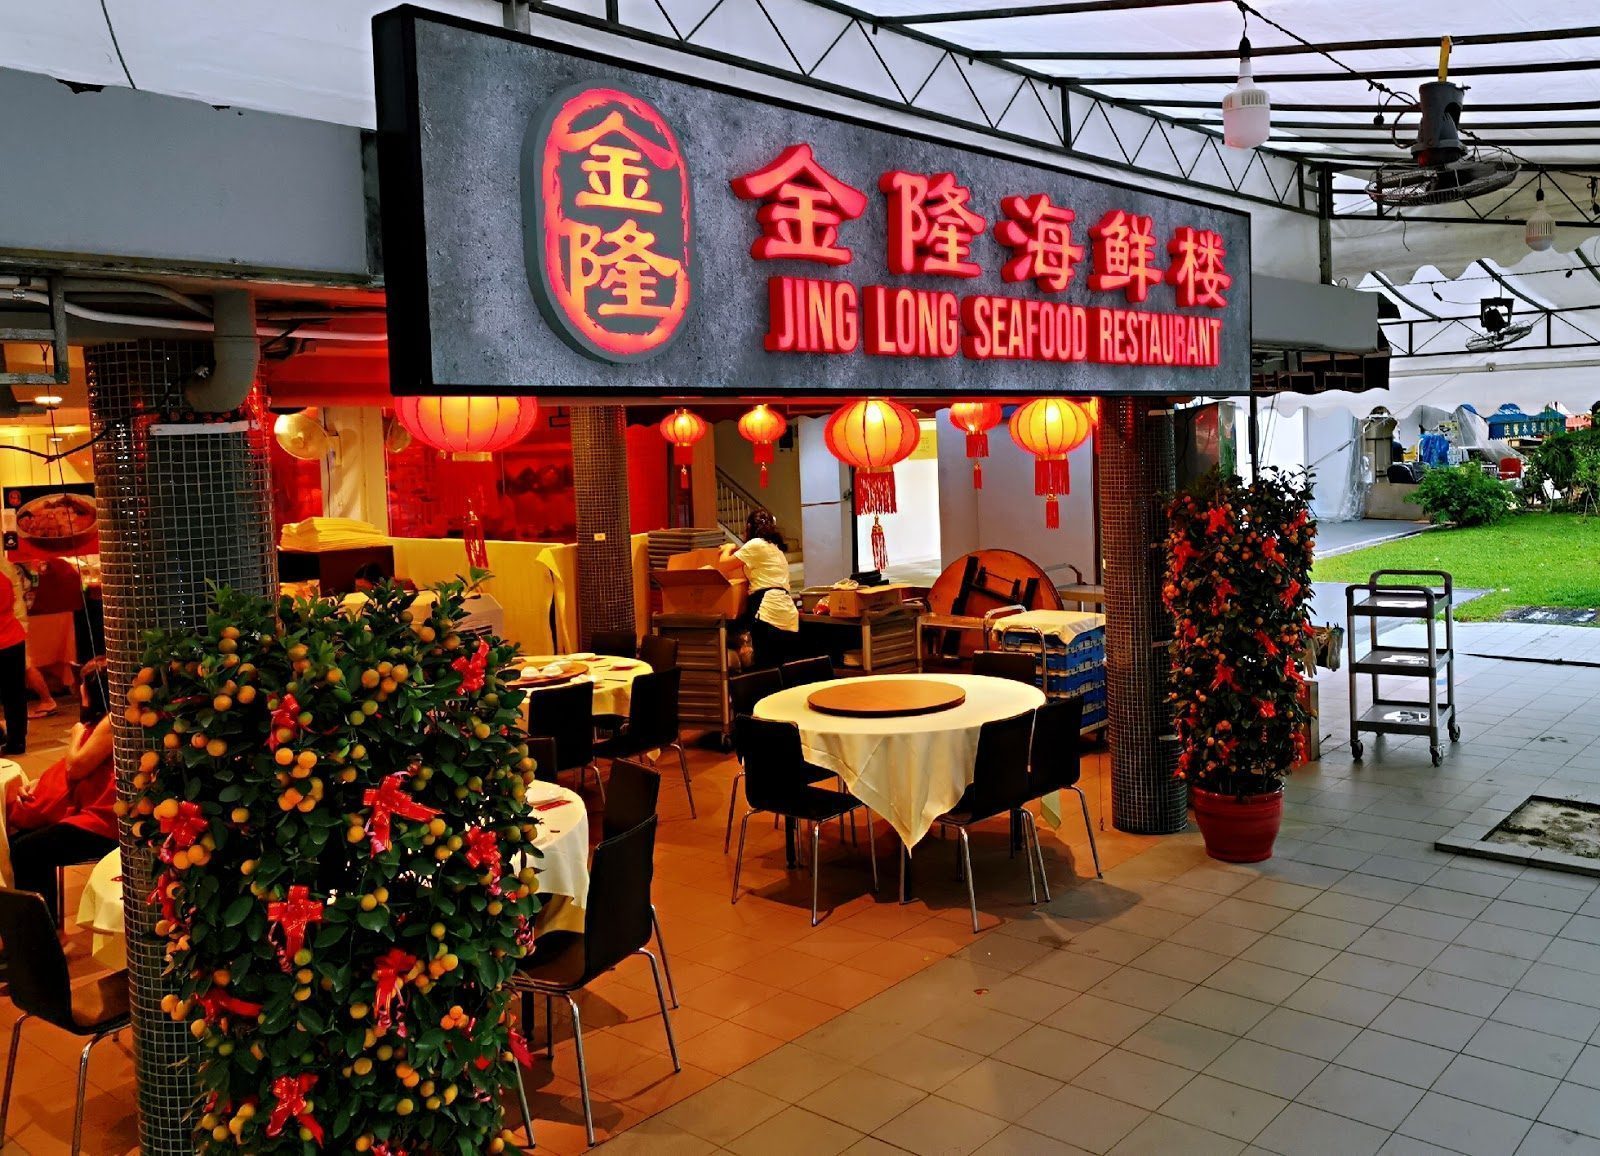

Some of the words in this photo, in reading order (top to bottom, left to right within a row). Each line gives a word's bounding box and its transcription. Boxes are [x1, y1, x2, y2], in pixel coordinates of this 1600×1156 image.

[556, 110, 682, 316] 金隆
[734, 144, 1232, 307] 金隆海鲜楼
[767, 277, 859, 354] JING
[867, 286, 959, 358] LONG
[964, 296, 1087, 361] SEAFOOD
[1096, 308, 1222, 367] RESTAURANT
